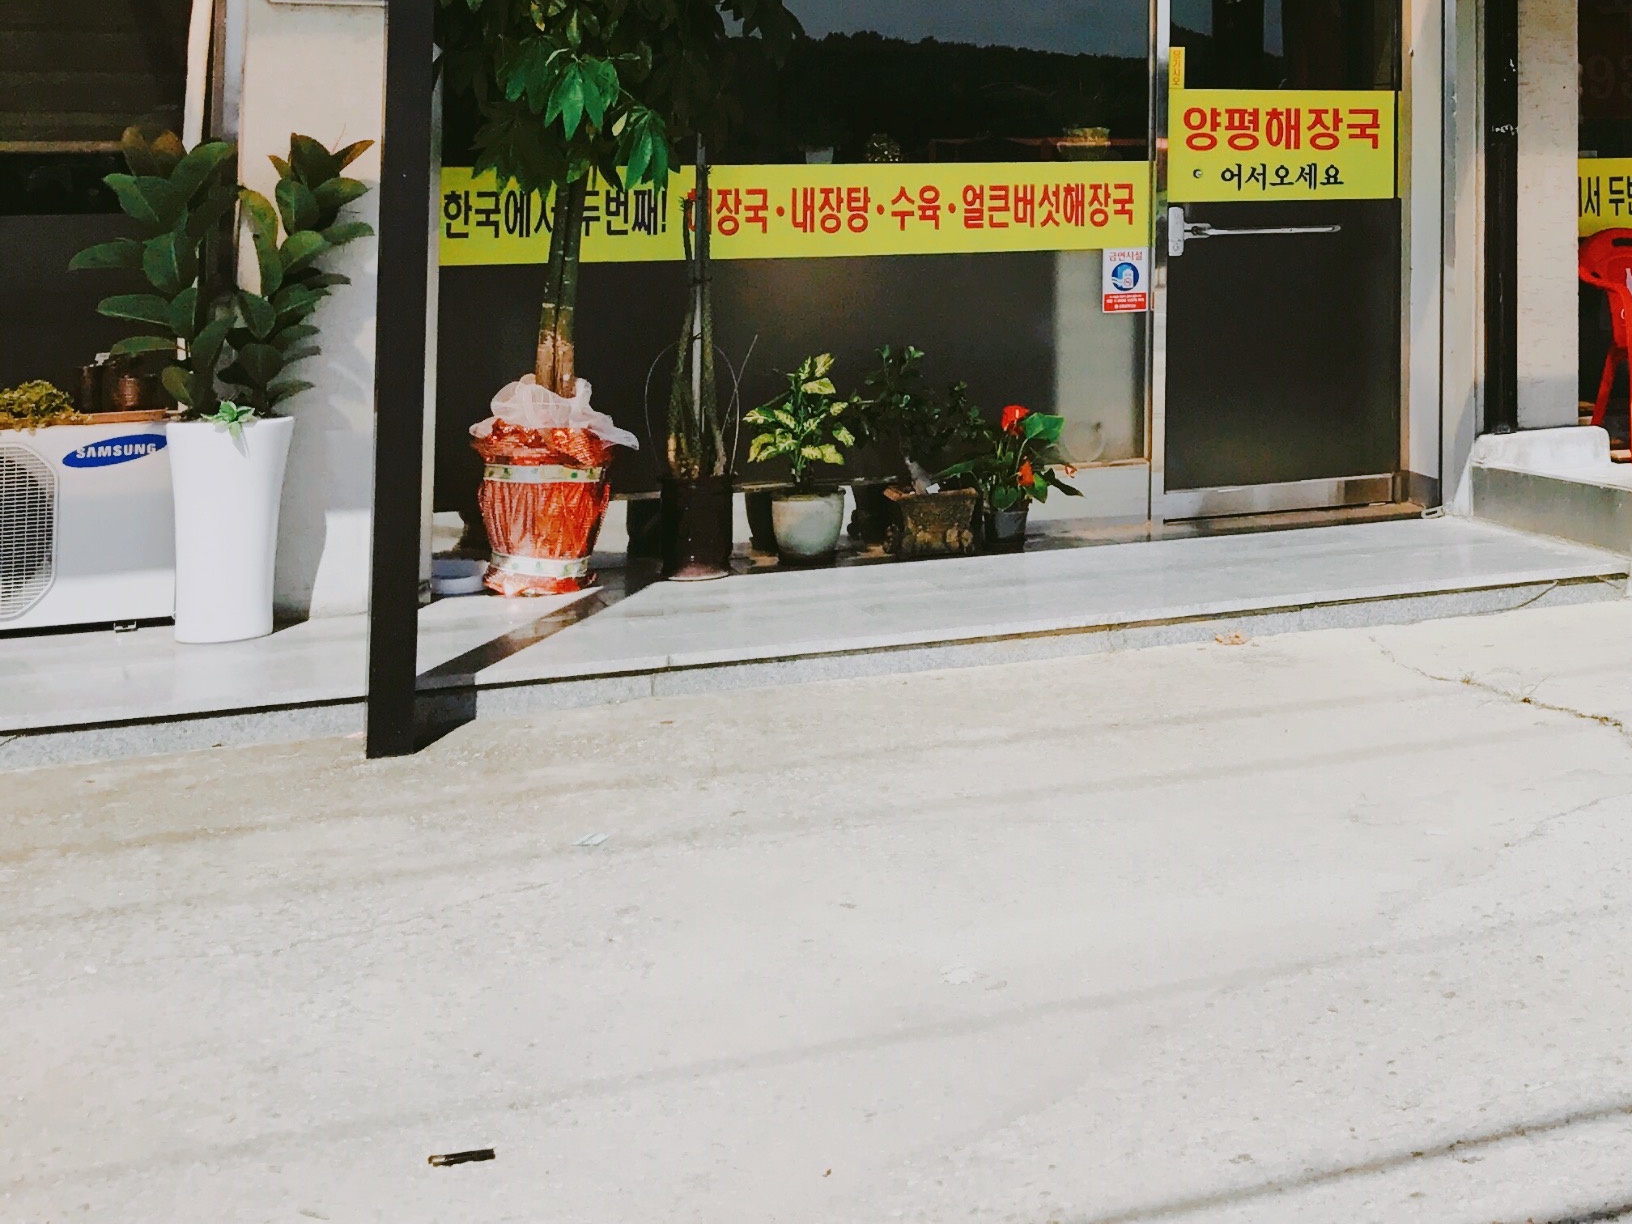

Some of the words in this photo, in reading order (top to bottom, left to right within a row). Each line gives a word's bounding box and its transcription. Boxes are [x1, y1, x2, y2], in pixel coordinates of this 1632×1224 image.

[1183, 107, 1380, 150] 양평해장국
[1221, 163, 1344, 191] 어서오세요
[1109, 251, 1143, 262] 금연시설
[76, 443, 156, 459] SAMSUNG
